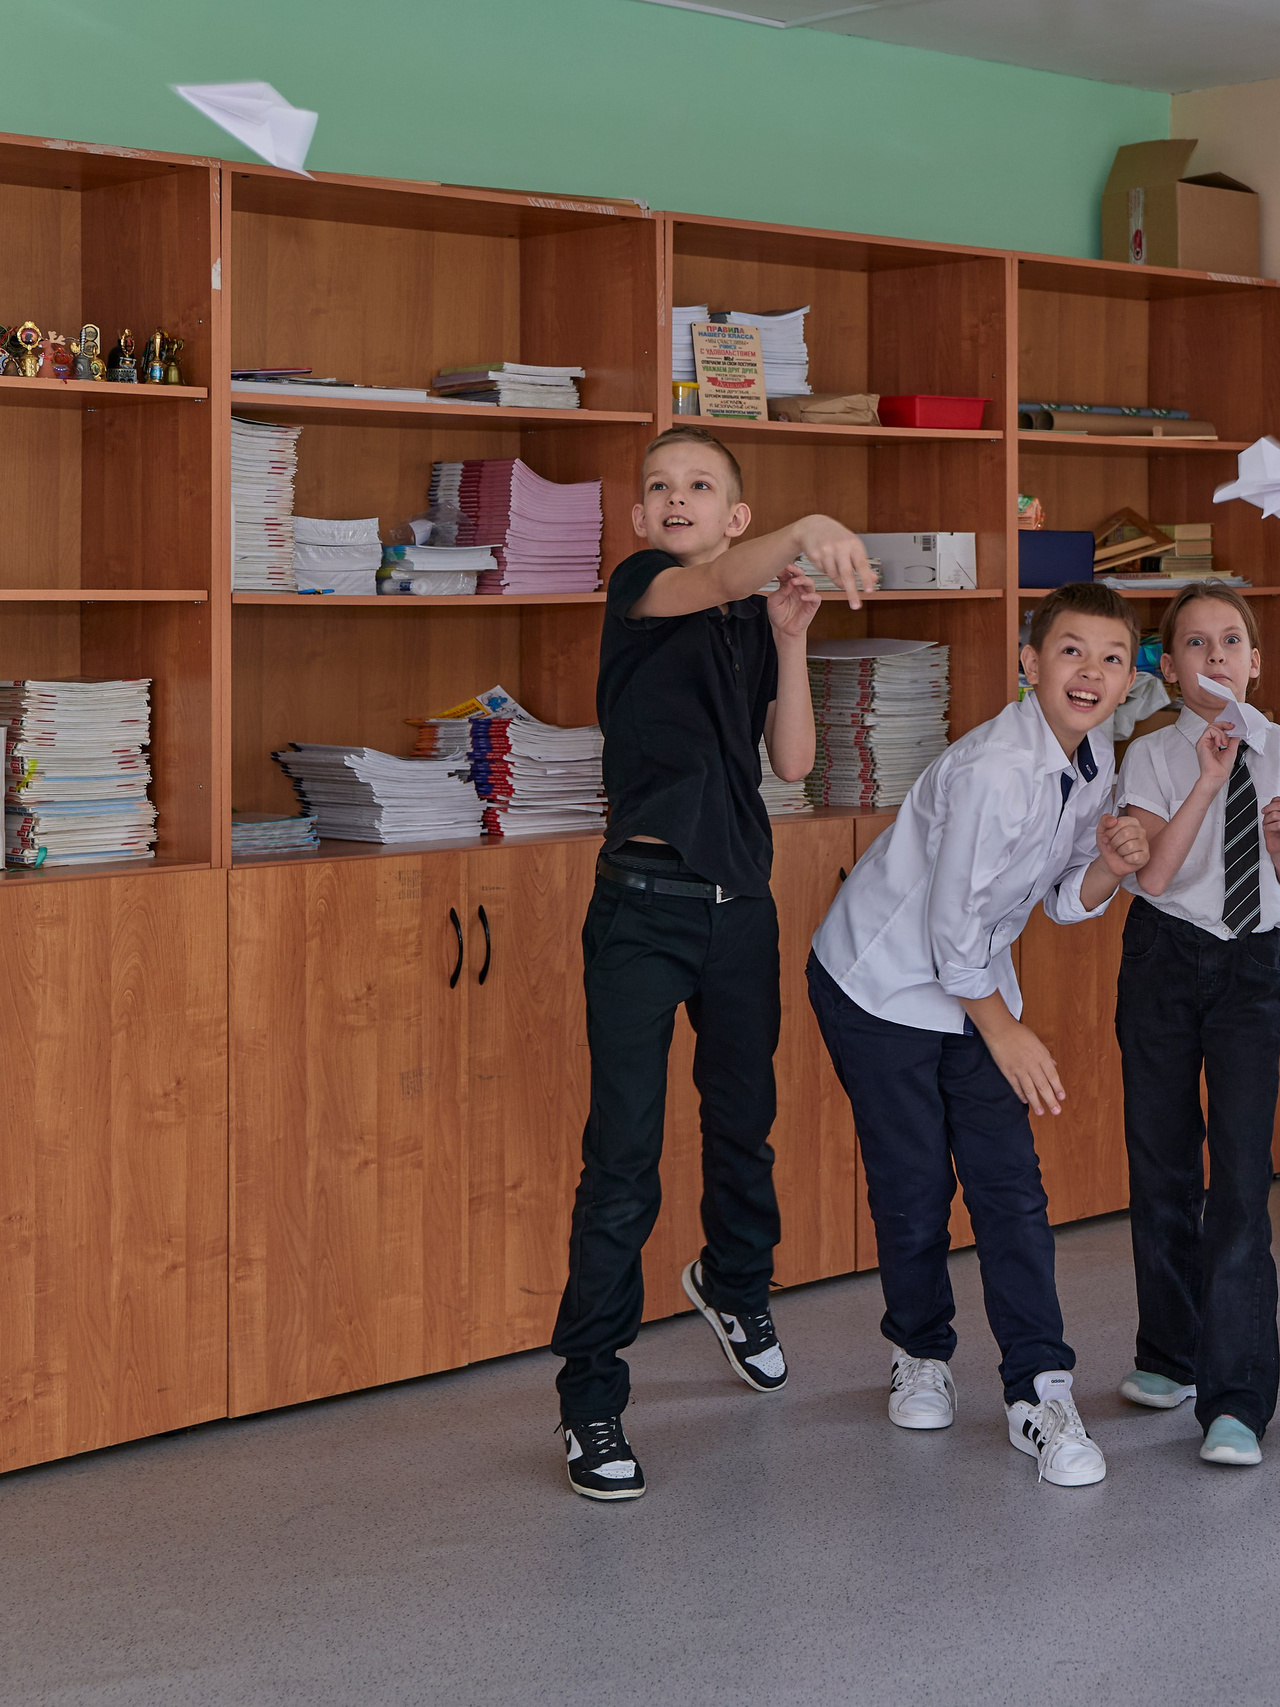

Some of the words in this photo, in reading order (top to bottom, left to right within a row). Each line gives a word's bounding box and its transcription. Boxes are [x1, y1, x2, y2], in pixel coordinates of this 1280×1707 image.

[706, 325, 745, 334] ПРАВИЛА
[698, 331, 726, 339] НАШЕГО
[706, 349, 756, 357] УДОВОЛЬСТВИЕМ
